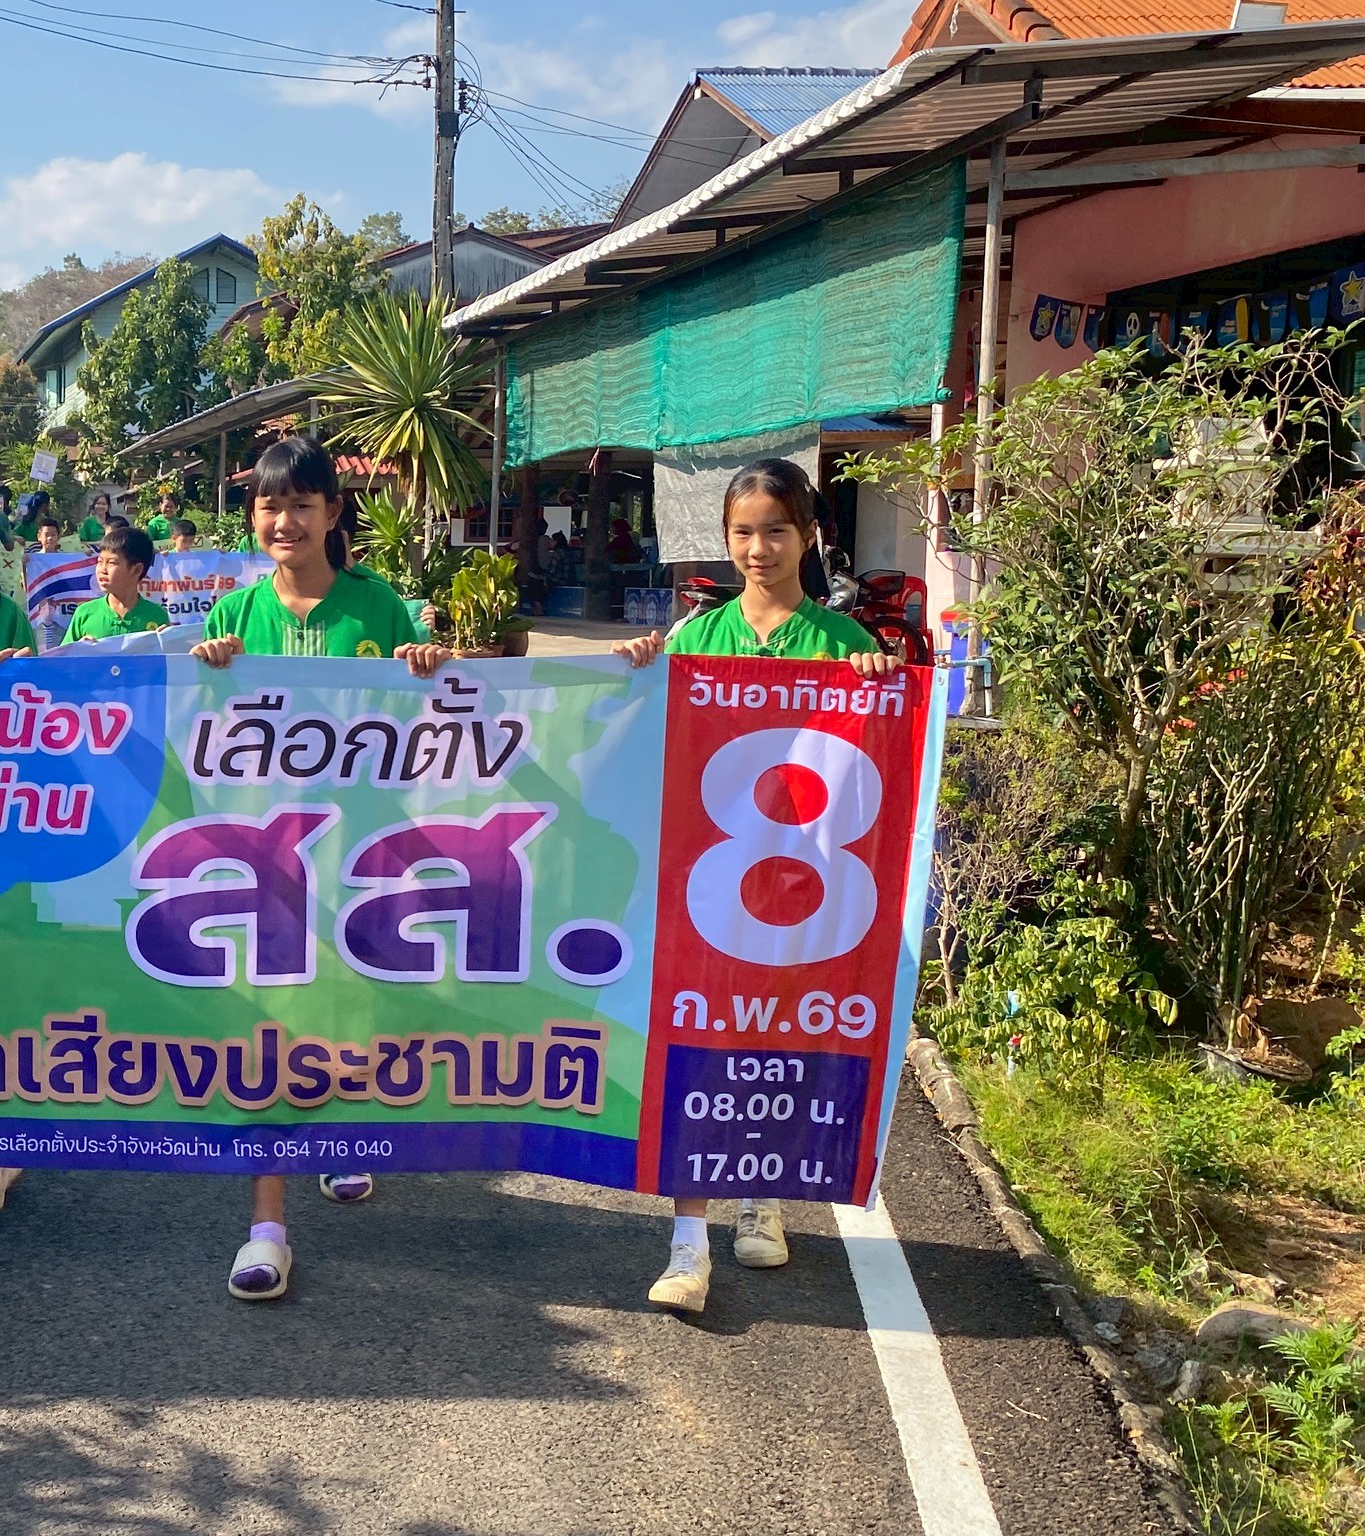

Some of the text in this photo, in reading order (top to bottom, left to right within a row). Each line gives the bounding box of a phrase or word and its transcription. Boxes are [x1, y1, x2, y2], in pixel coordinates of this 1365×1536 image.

[688, 672, 907, 717] วันอาทิตย์ที่
[192, 676, 525, 781] เลือกตั้ง
[686, 727, 883, 967] 8
[133, 808, 625, 979] สส.
[672, 989, 878, 1040] ก.พ.69
[725, 1056, 805, 1083] เวลา
[684, 1091, 845, 1125] 08.00 น.
[232, 1138, 268, 1158] โทร.
[273, 1140, 311, 1158] 054
[317, 1139, 349, 1158] 716
[354, 1139, 393, 1158] 040
[686, 1153, 833, 1184] 17.00 น.
